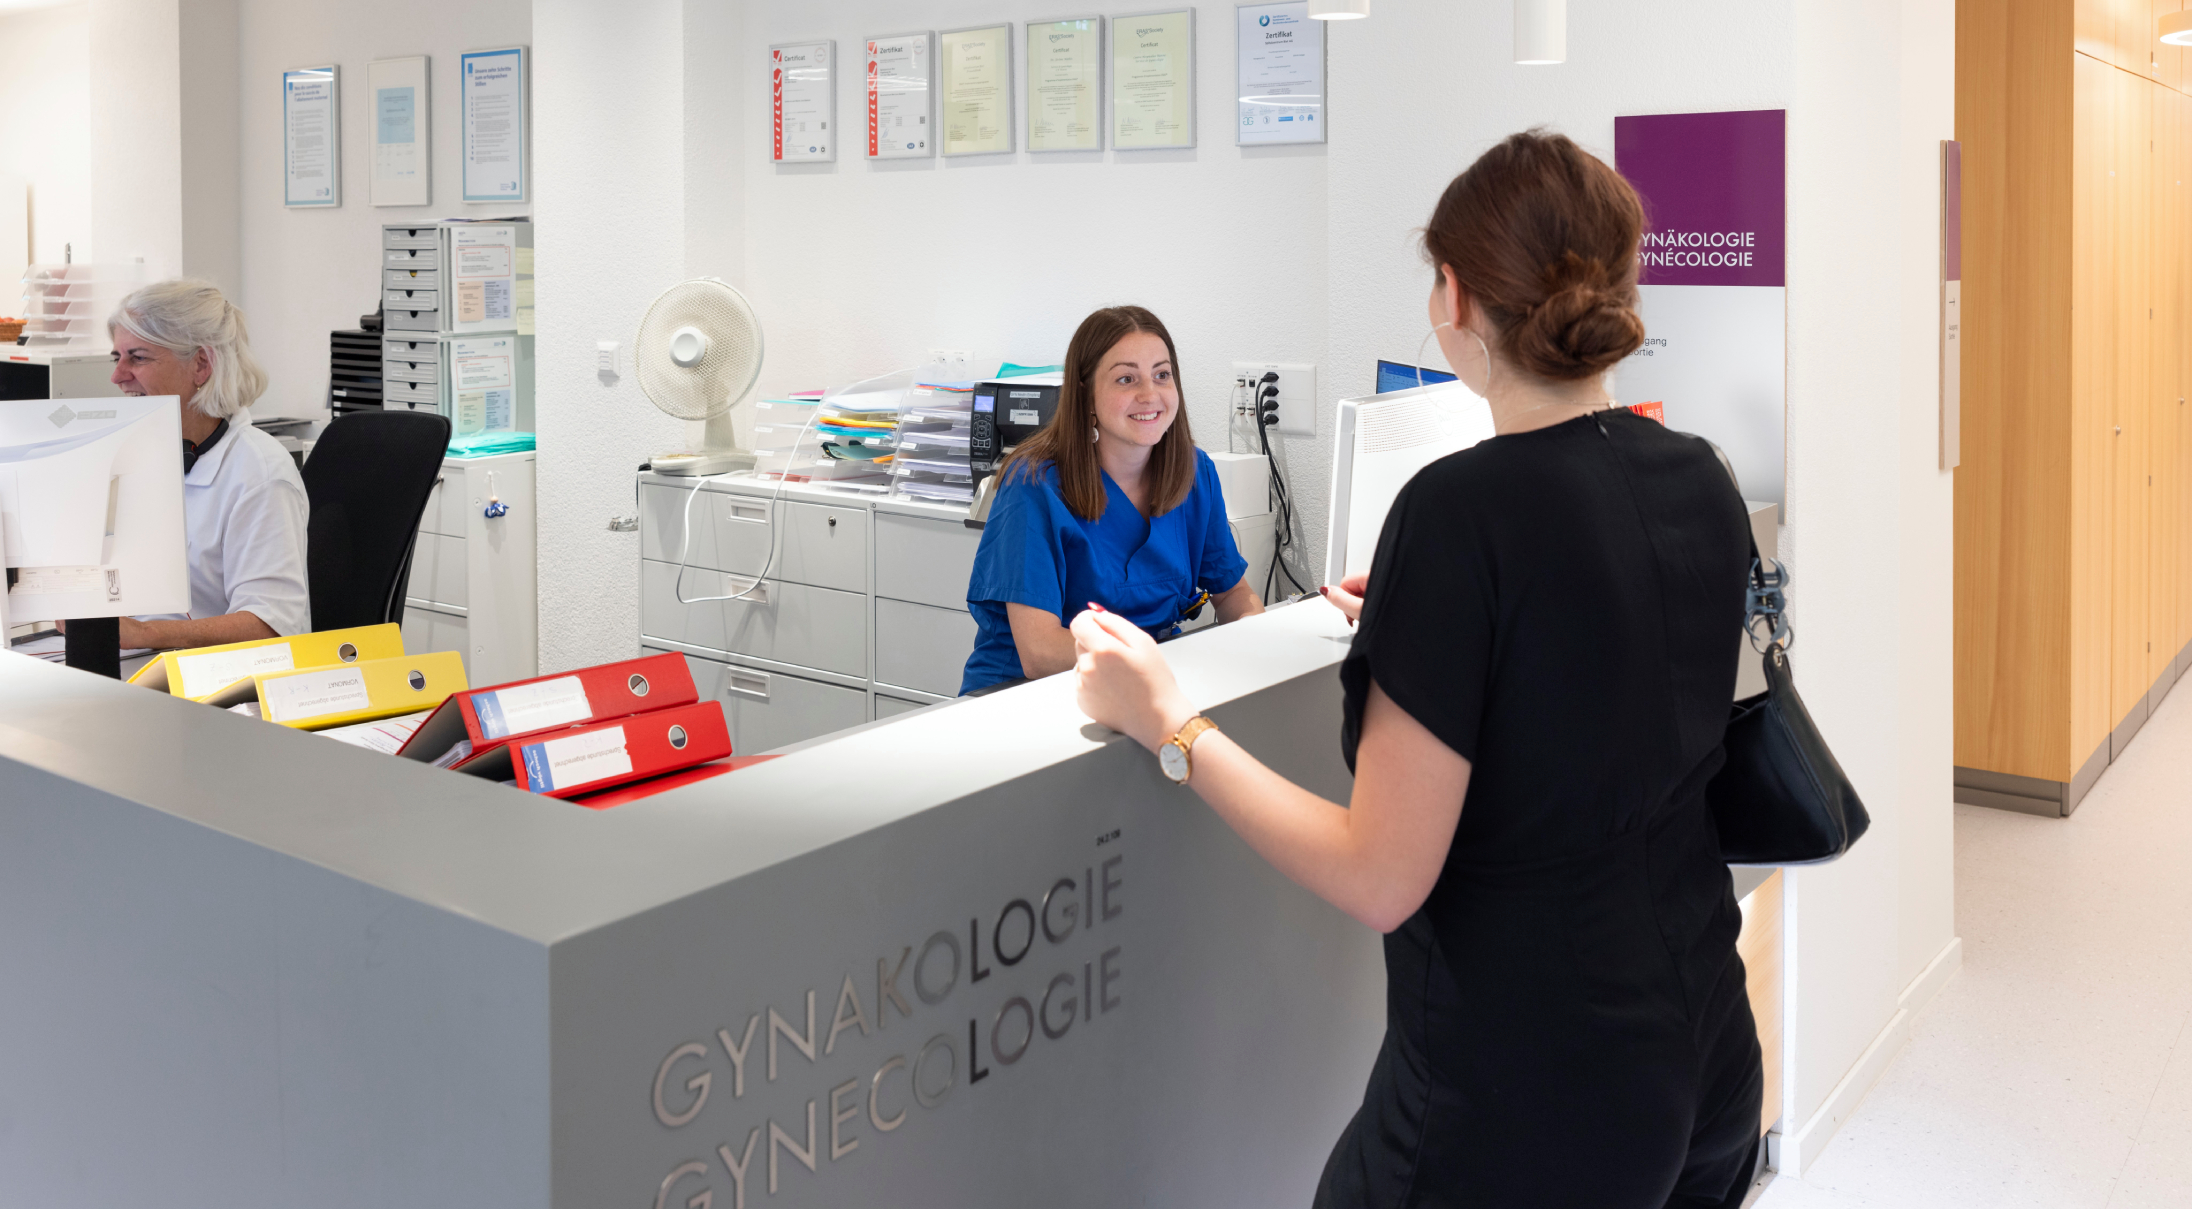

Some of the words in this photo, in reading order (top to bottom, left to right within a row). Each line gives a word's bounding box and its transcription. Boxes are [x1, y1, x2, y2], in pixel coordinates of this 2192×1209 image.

[1265, 31, 1292, 39] Zertifikat
[880, 46, 903, 54] Zertifikat
[1638, 229, 1755, 247] YNÄKOLOGIE
[1641, 338, 1667, 347] gang
[77, 410, 117, 420] EIZO
[254, 654, 289, 666] VORMONAT
[327, 678, 359, 689] VORMONAT
[330, 691, 364, 702] Sprechstunde
[586, 746, 622, 760] Sprechstunde
[553, 756, 586, 768] abgerechnet
[650, 853, 1123, 1127] GYNAKOLOGIE
[653, 945, 1122, 1209] GYNECOLOGIE
